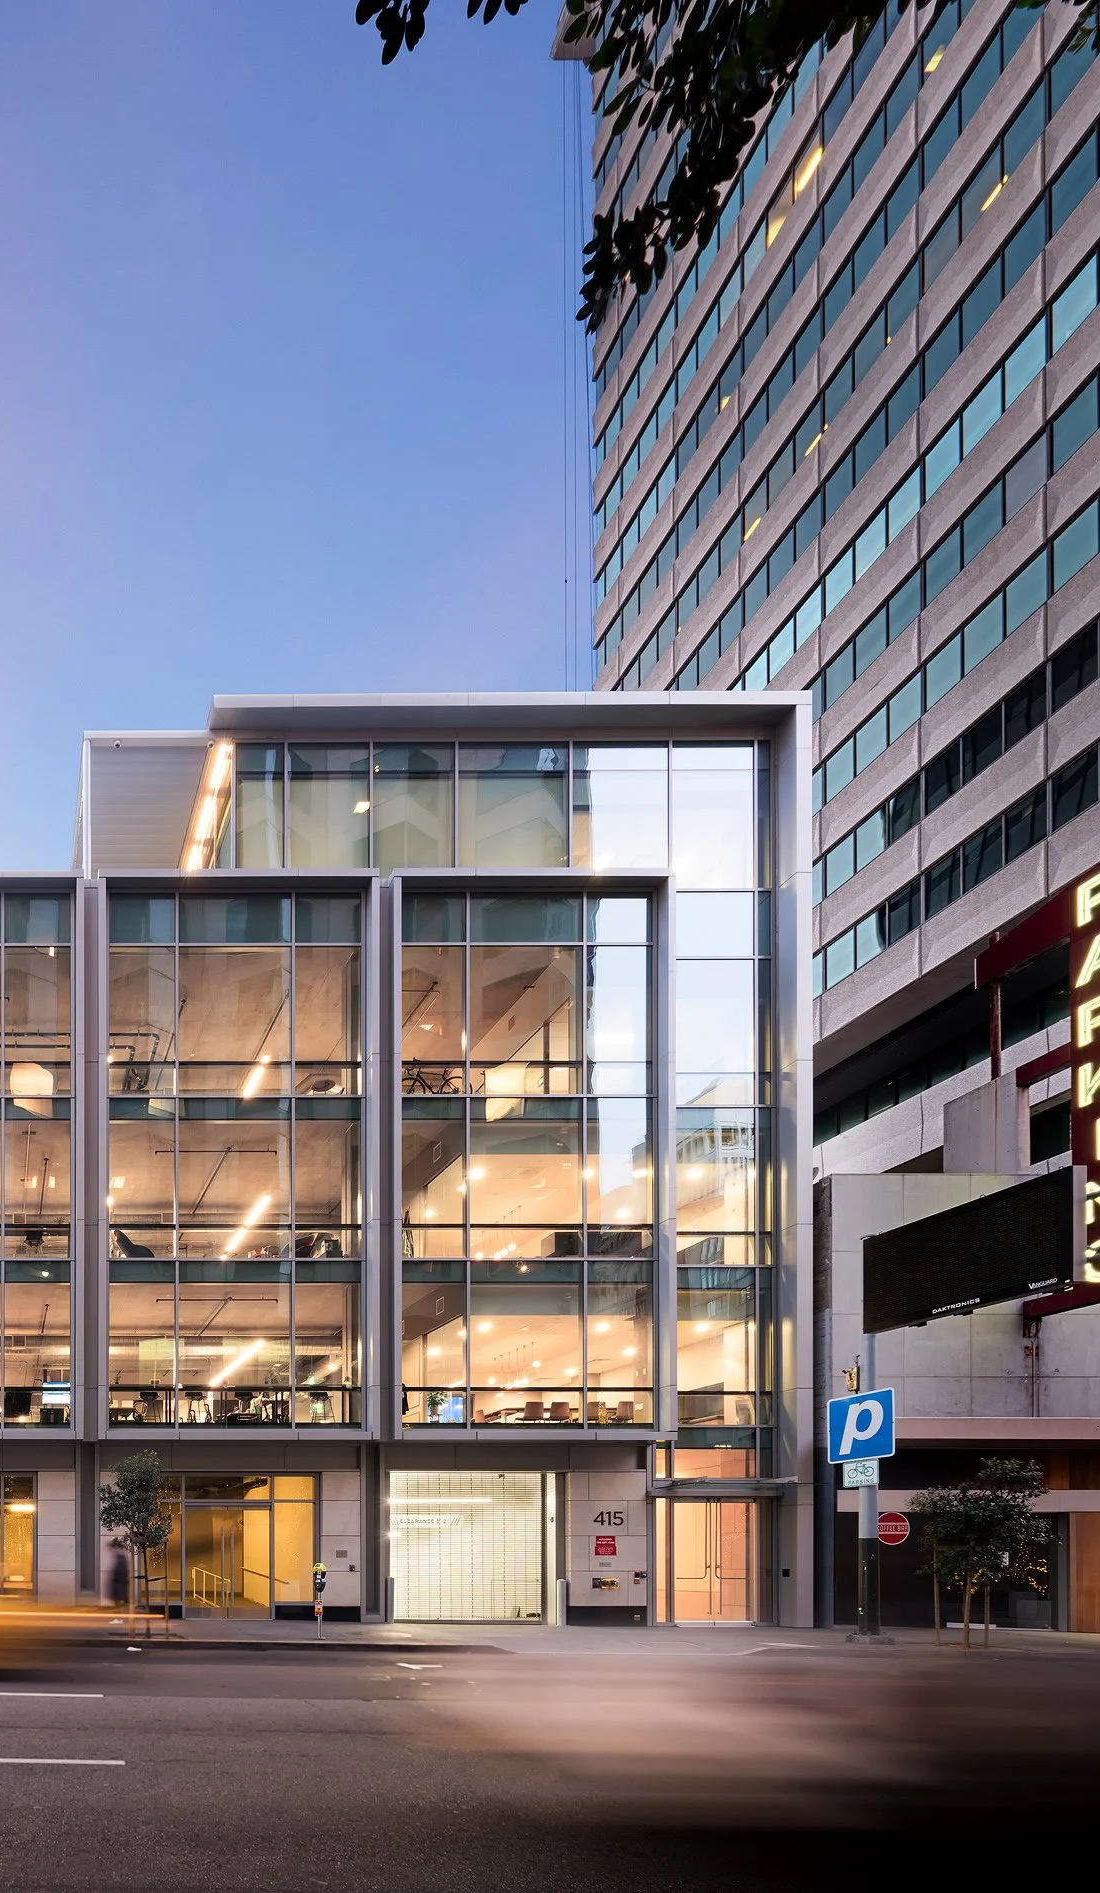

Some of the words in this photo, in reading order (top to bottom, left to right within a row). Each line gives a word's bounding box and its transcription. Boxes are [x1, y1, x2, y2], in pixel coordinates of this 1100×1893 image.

[1028, 1277, 1058, 1290] VANGUARD
[931, 1297, 980, 1314] DAKTRONICS
[848, 1478, 874, 1486] PARKING
[593, 1511, 624, 1526] 415
